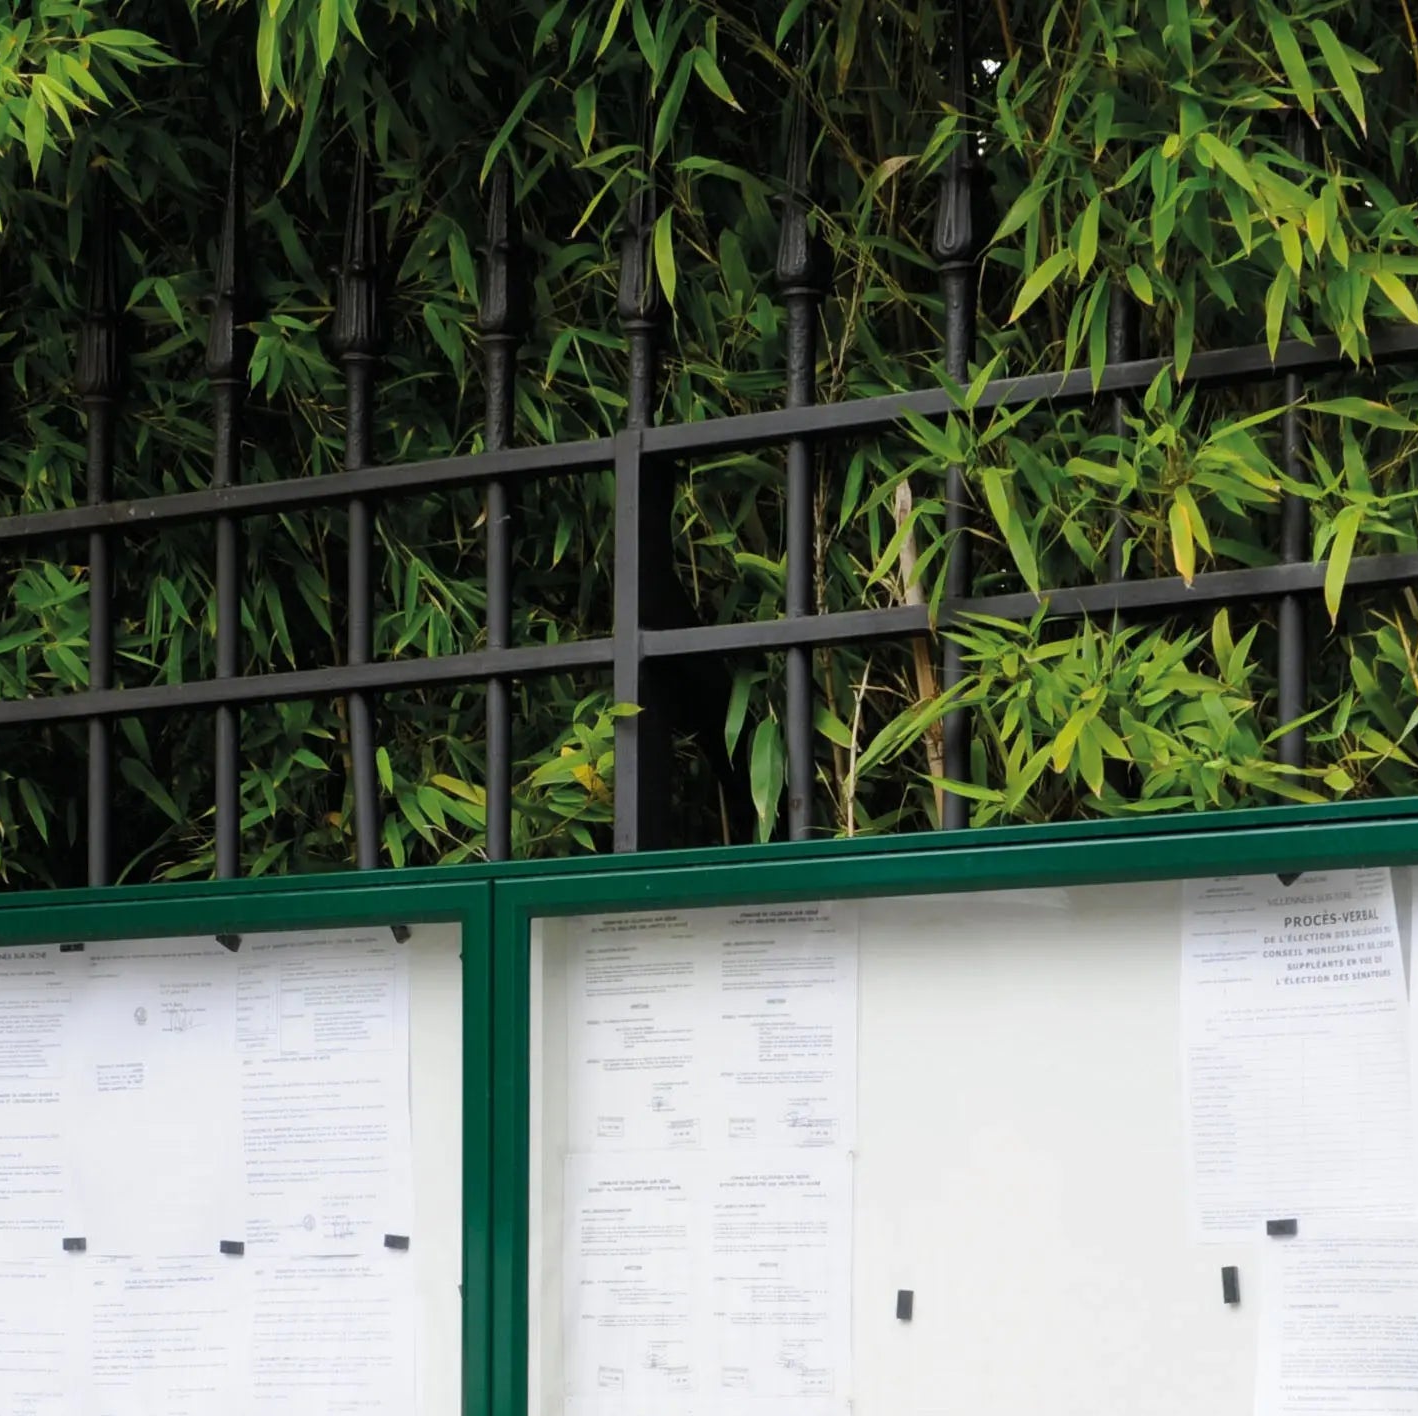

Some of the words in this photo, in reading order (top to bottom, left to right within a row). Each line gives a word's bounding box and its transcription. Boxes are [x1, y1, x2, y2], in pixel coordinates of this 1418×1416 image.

[1284, 908, 1380, 928] PROCÈS-VERBAL
[1263, 936, 1276, 944] DE
[1262, 948, 1303, 958] CONSEIL
[1306, 943, 1355, 956] MUNICIPAL
[1286, 959, 1344, 971] SUPPLÉANTS
[1333, 972, 1350, 982] DES
